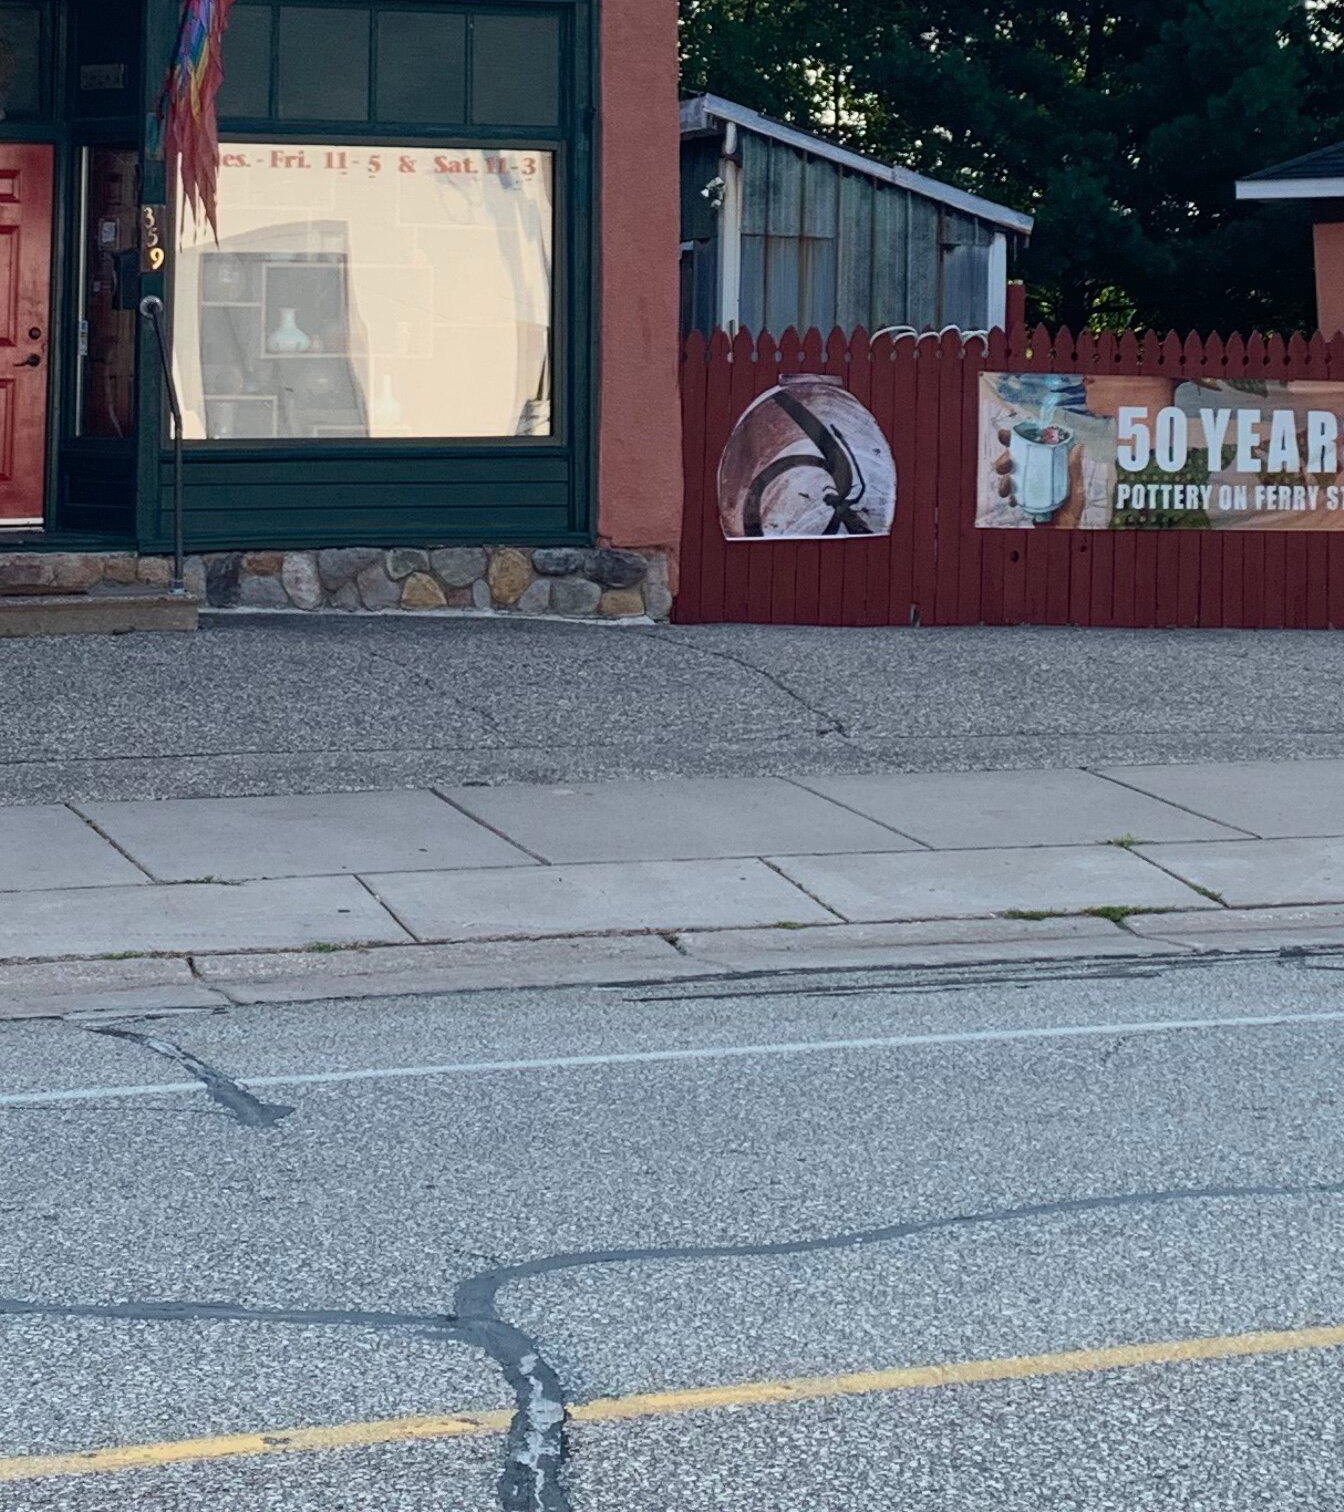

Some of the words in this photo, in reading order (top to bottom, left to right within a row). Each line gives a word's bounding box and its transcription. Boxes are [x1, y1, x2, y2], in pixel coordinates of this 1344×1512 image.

[398, 155, 417, 174] &
[1117, 406, 1188, 473] 50
[1115, 484, 1214, 510] POTTERY
[1218, 484, 1248, 511] ON
[1255, 484, 1319, 512] FERRY
